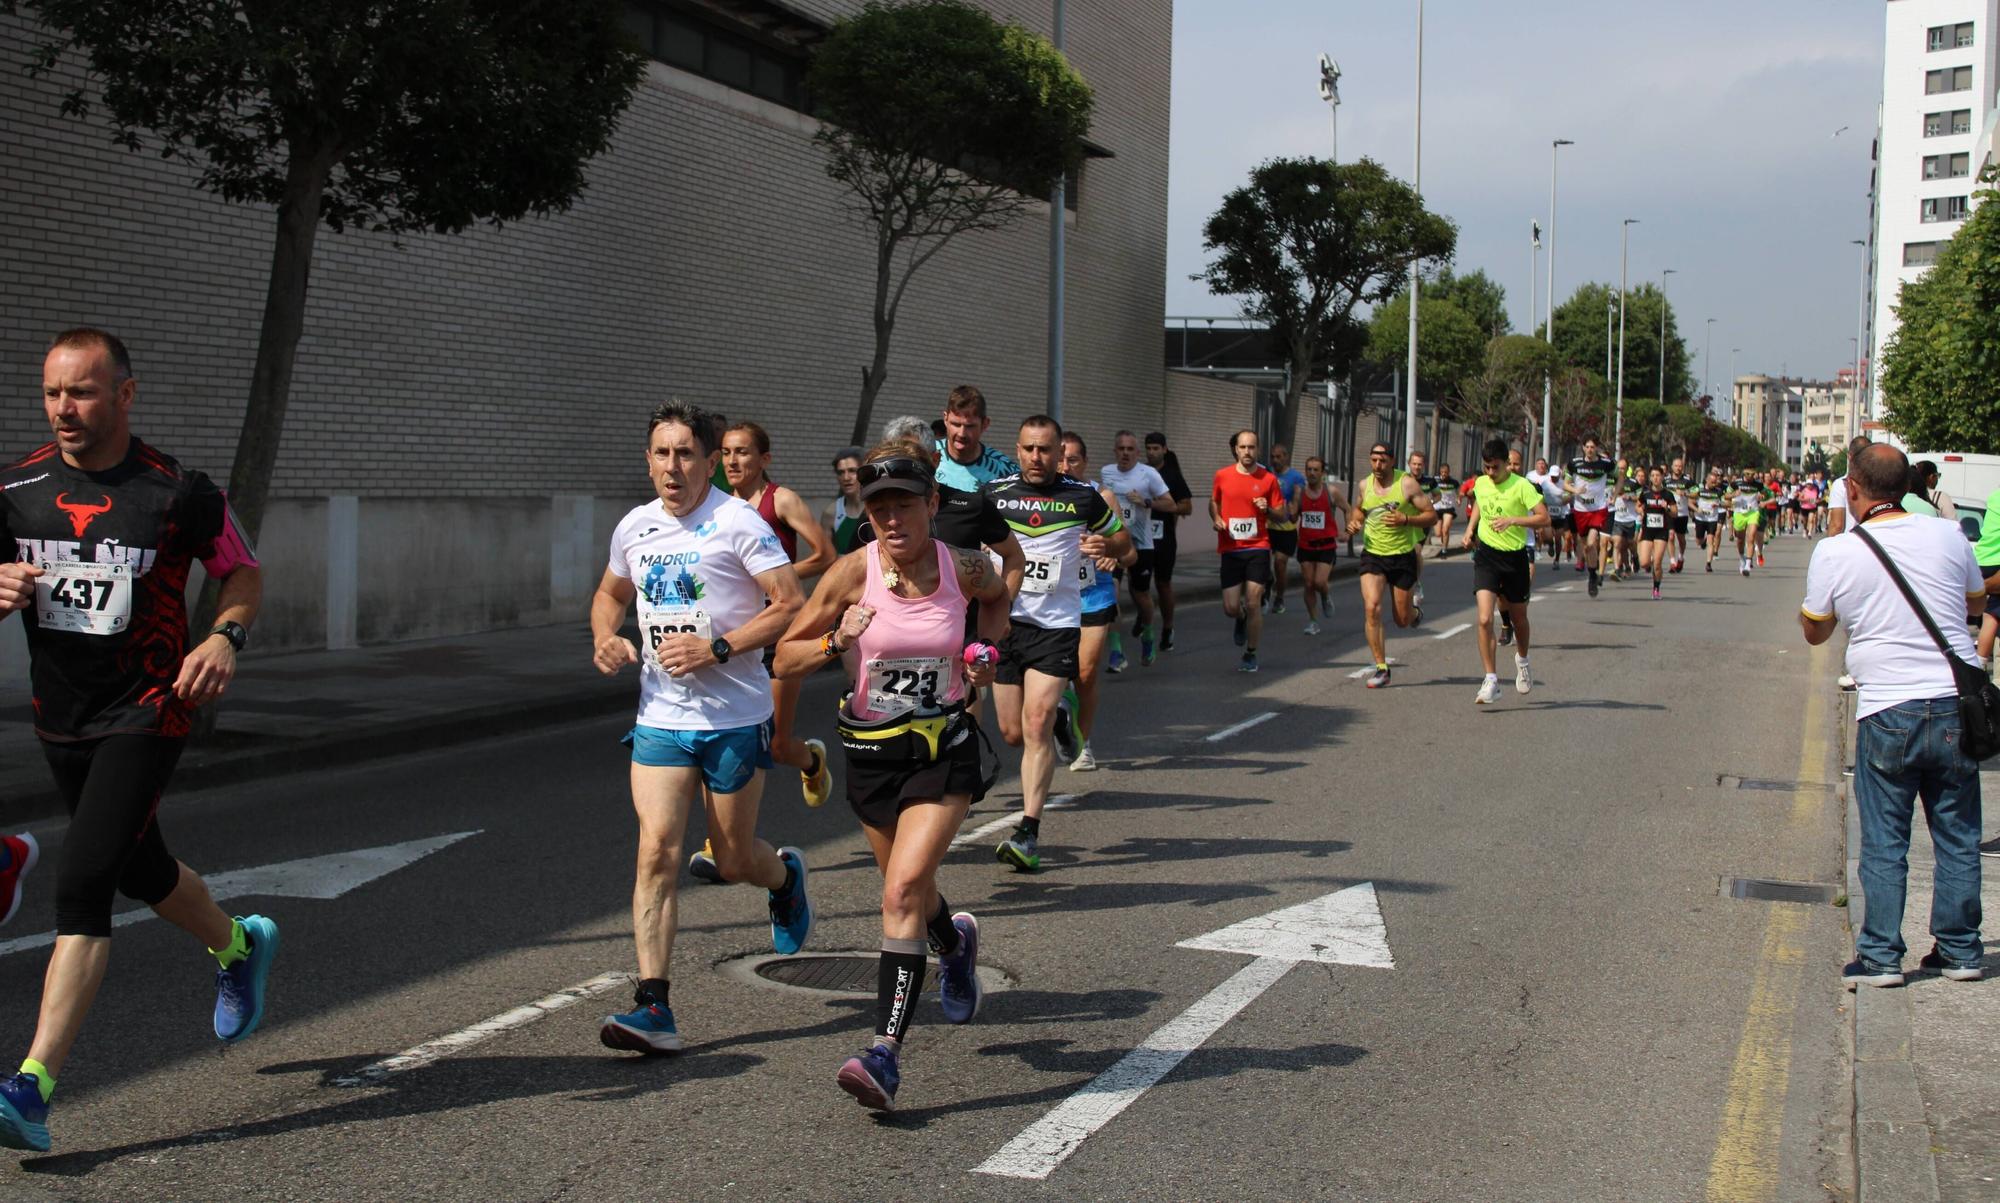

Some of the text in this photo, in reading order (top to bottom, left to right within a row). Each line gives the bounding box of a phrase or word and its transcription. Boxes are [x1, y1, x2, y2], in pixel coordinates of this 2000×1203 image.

[997, 499, 1077, 514] DONAVIDA
[1233, 522, 1252, 532] 407
[15, 538, 80, 562] THE
[640, 551, 701, 567] MADRID
[51, 578, 114, 611] 437
[882, 669, 938, 696] 223
